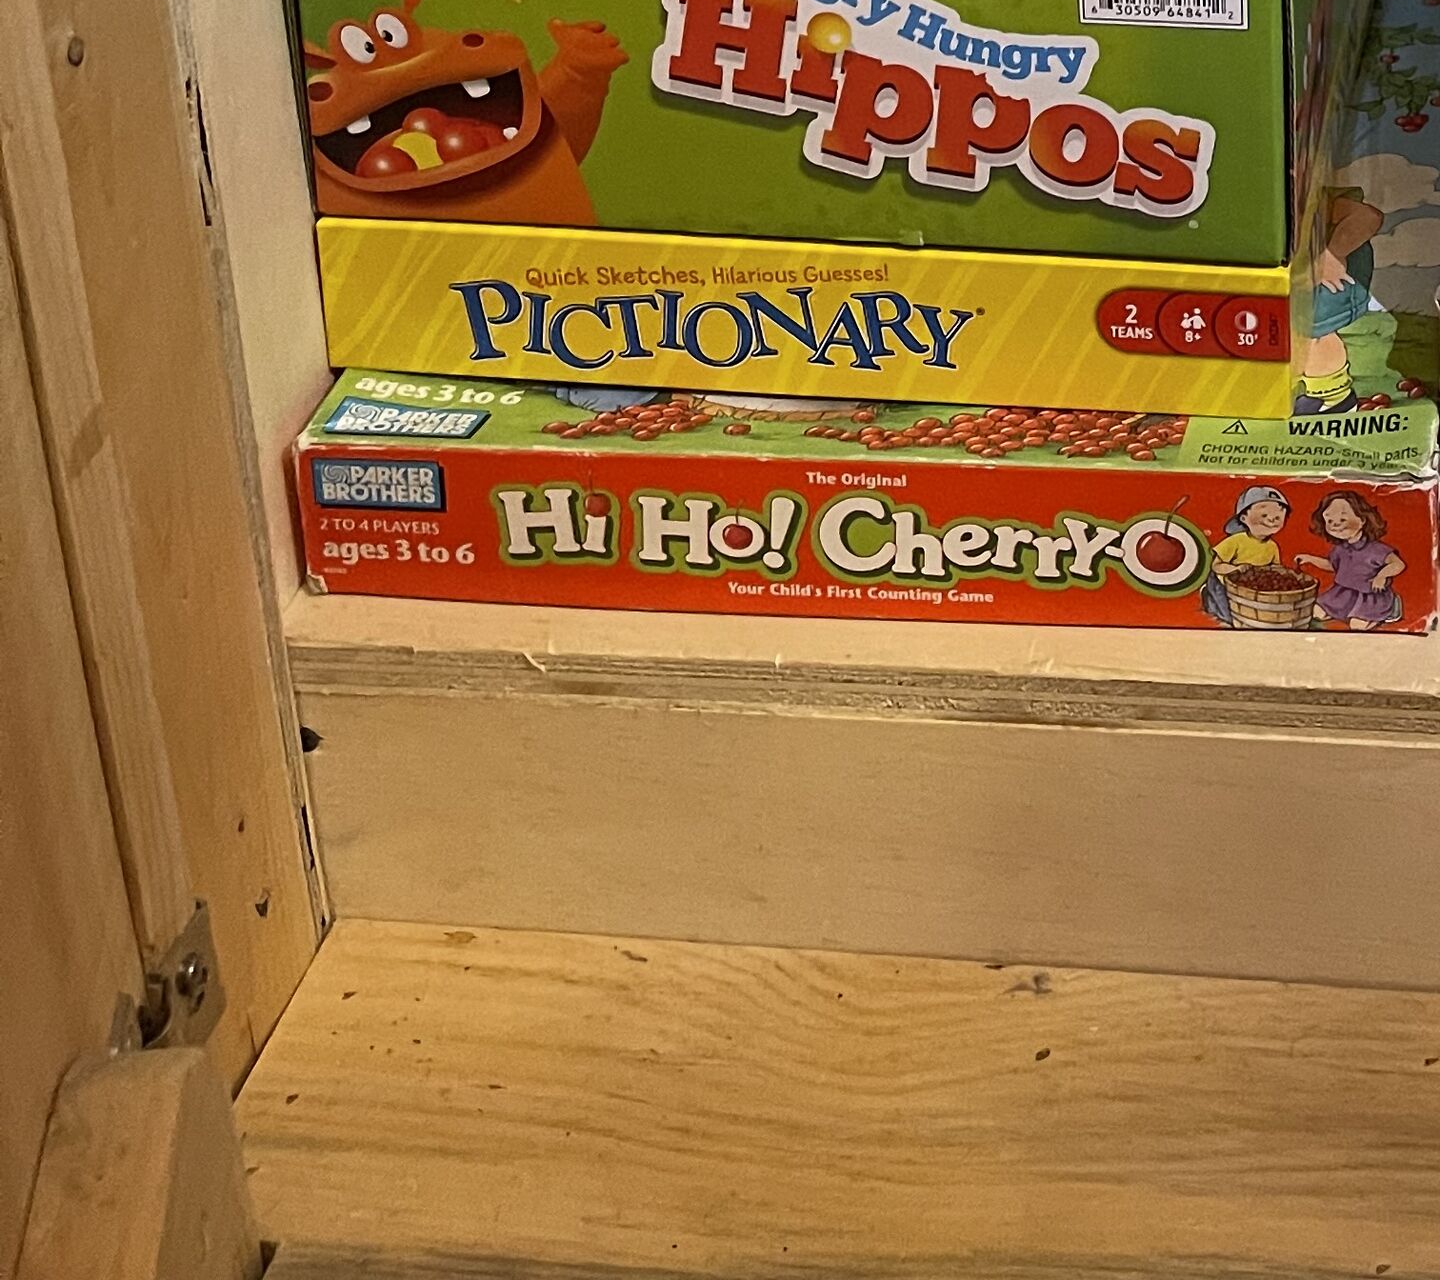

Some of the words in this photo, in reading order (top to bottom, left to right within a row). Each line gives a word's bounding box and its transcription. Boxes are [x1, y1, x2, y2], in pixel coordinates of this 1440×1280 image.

[1115, 4, 1161, 18] 30509
[1166, 5, 1212, 19] 64841
[898, 2, 1086, 84] Hungry
[525, 266, 589, 288] Quick
[596, 266, 706, 288] Sketches,
[711, 266, 798, 286] Hilarious
[803, 265, 889, 286] Guesses!
[449, 278, 976, 371] PICTIONARY
[1125, 304, 1138, 324] 2
[1110, 325, 1154, 341] TEAMS
[355, 375, 428, 402] ages
[437, 385, 456, 401] 3
[460, 387, 495, 404] to
[500, 389, 526, 406] 6
[1288, 414, 1410, 439] WARNING:
[1201, 443, 1257, 457] CHOKING
[1197, 453, 1223, 466] Not
[1225, 455, 1244, 467] for
[1247, 455, 1308, 470] children
[1312, 457, 1354, 471] under
[349, 466, 435, 487] PARKER
[805, 471, 837, 486] The
[841, 472, 907, 488] Original
[321, 481, 436, 506] BROTHERS
[332, 518, 354, 532] TO
[372, 519, 440, 535] PLAYERS
[498, 488, 617, 558] Hi
[635, 494, 797, 571] Ho!
[322, 542, 390, 567] ages
[395, 540, 414, 562] 3
[418, 543, 447, 564] to
[453, 544, 476, 565] 6
[728, 581, 765, 596] Your
[769, 582, 822, 599] Child's
[827, 584, 861, 599] First
[866, 587, 943, 605] Counting
[947, 589, 994, 604] Game
